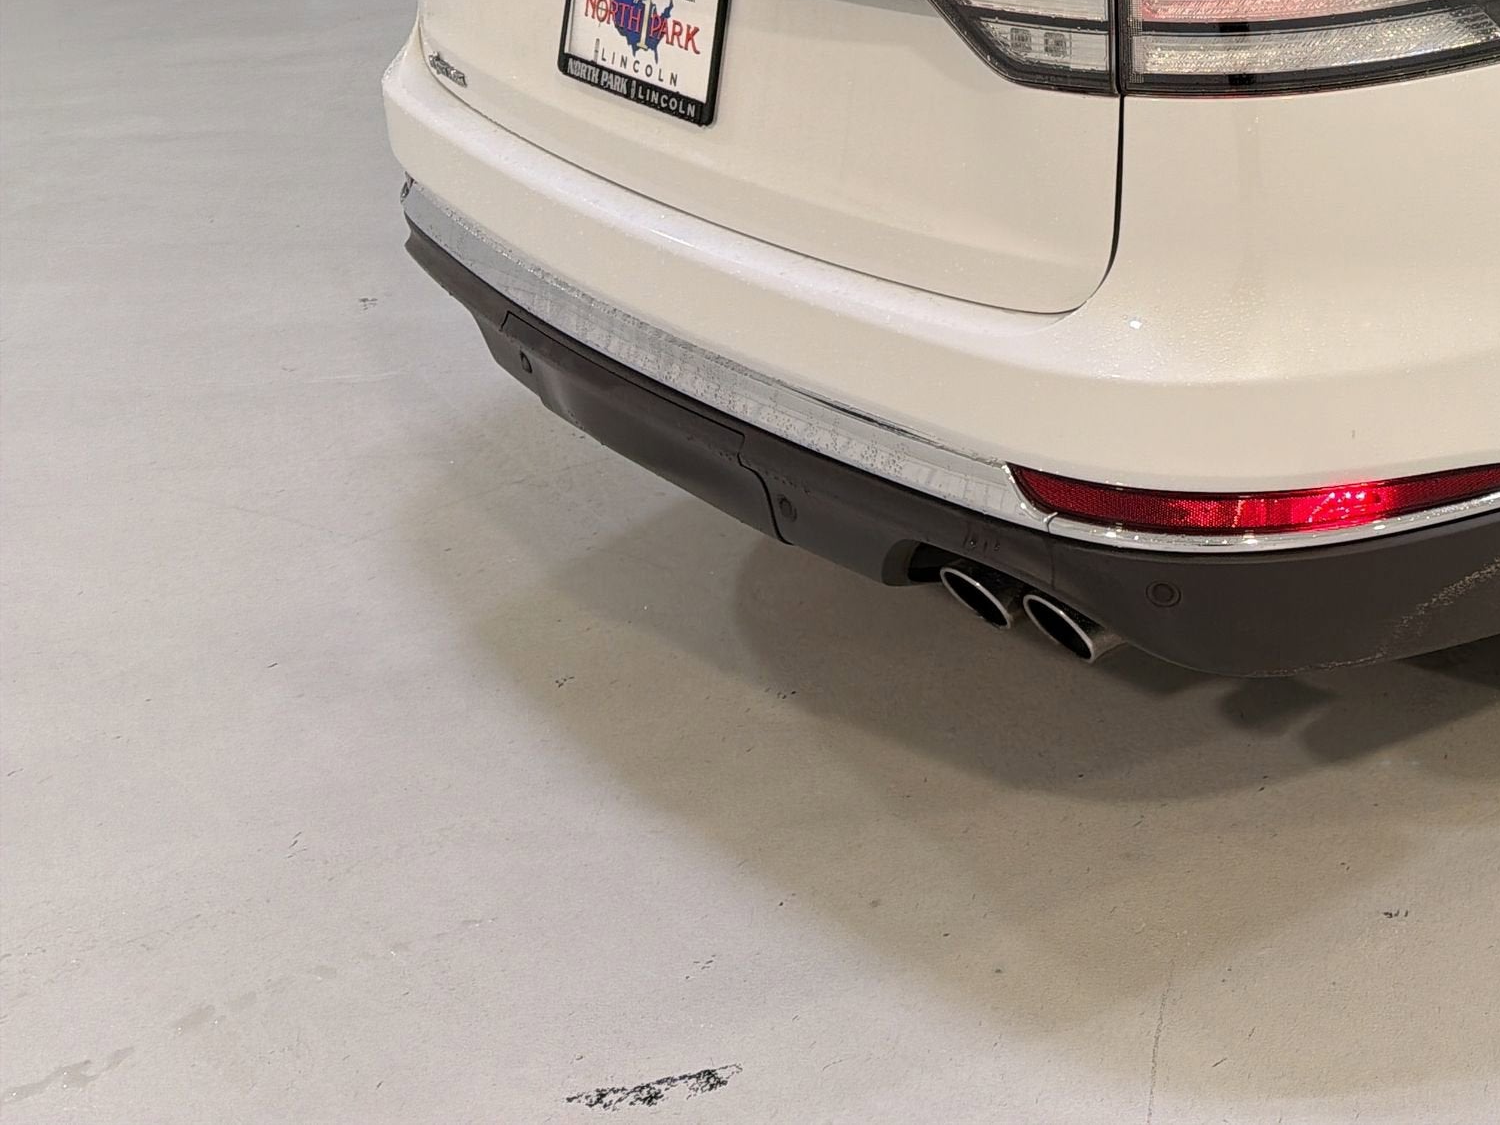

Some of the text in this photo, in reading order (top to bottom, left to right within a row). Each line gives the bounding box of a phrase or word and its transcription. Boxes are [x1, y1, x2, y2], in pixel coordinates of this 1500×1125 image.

[651, 11, 701, 55] PARK
[567, 57, 696, 118] NORTH PARK LINCOLN
[601, 48, 679, 87] LINCOLN
